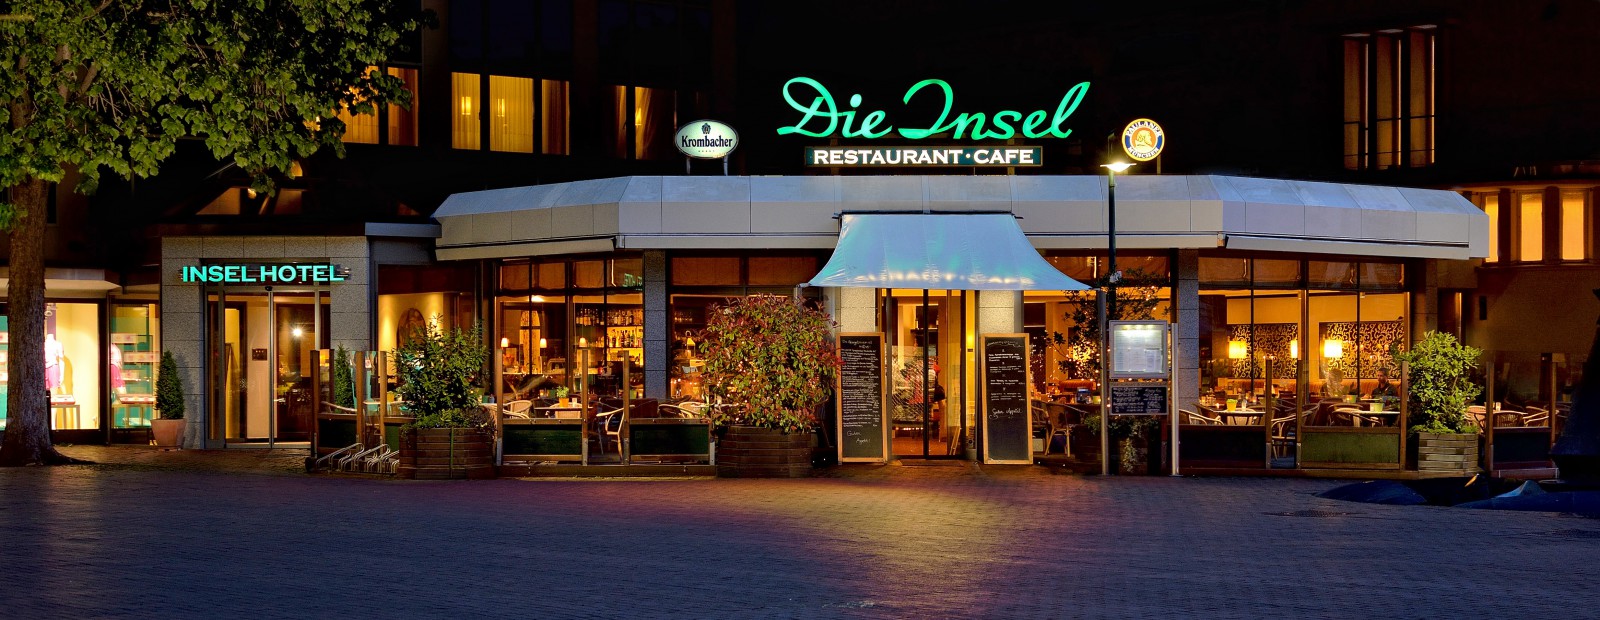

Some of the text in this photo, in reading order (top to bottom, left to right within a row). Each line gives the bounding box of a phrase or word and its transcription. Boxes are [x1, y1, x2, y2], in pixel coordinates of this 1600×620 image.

[776, 76, 1091, 140] Die Insel
[681, 134, 733, 148] Krombacher
[813, 149, 1034, 166] RESTAURANT CAFE
[182, 264, 345, 283] INSEL HOTEL
